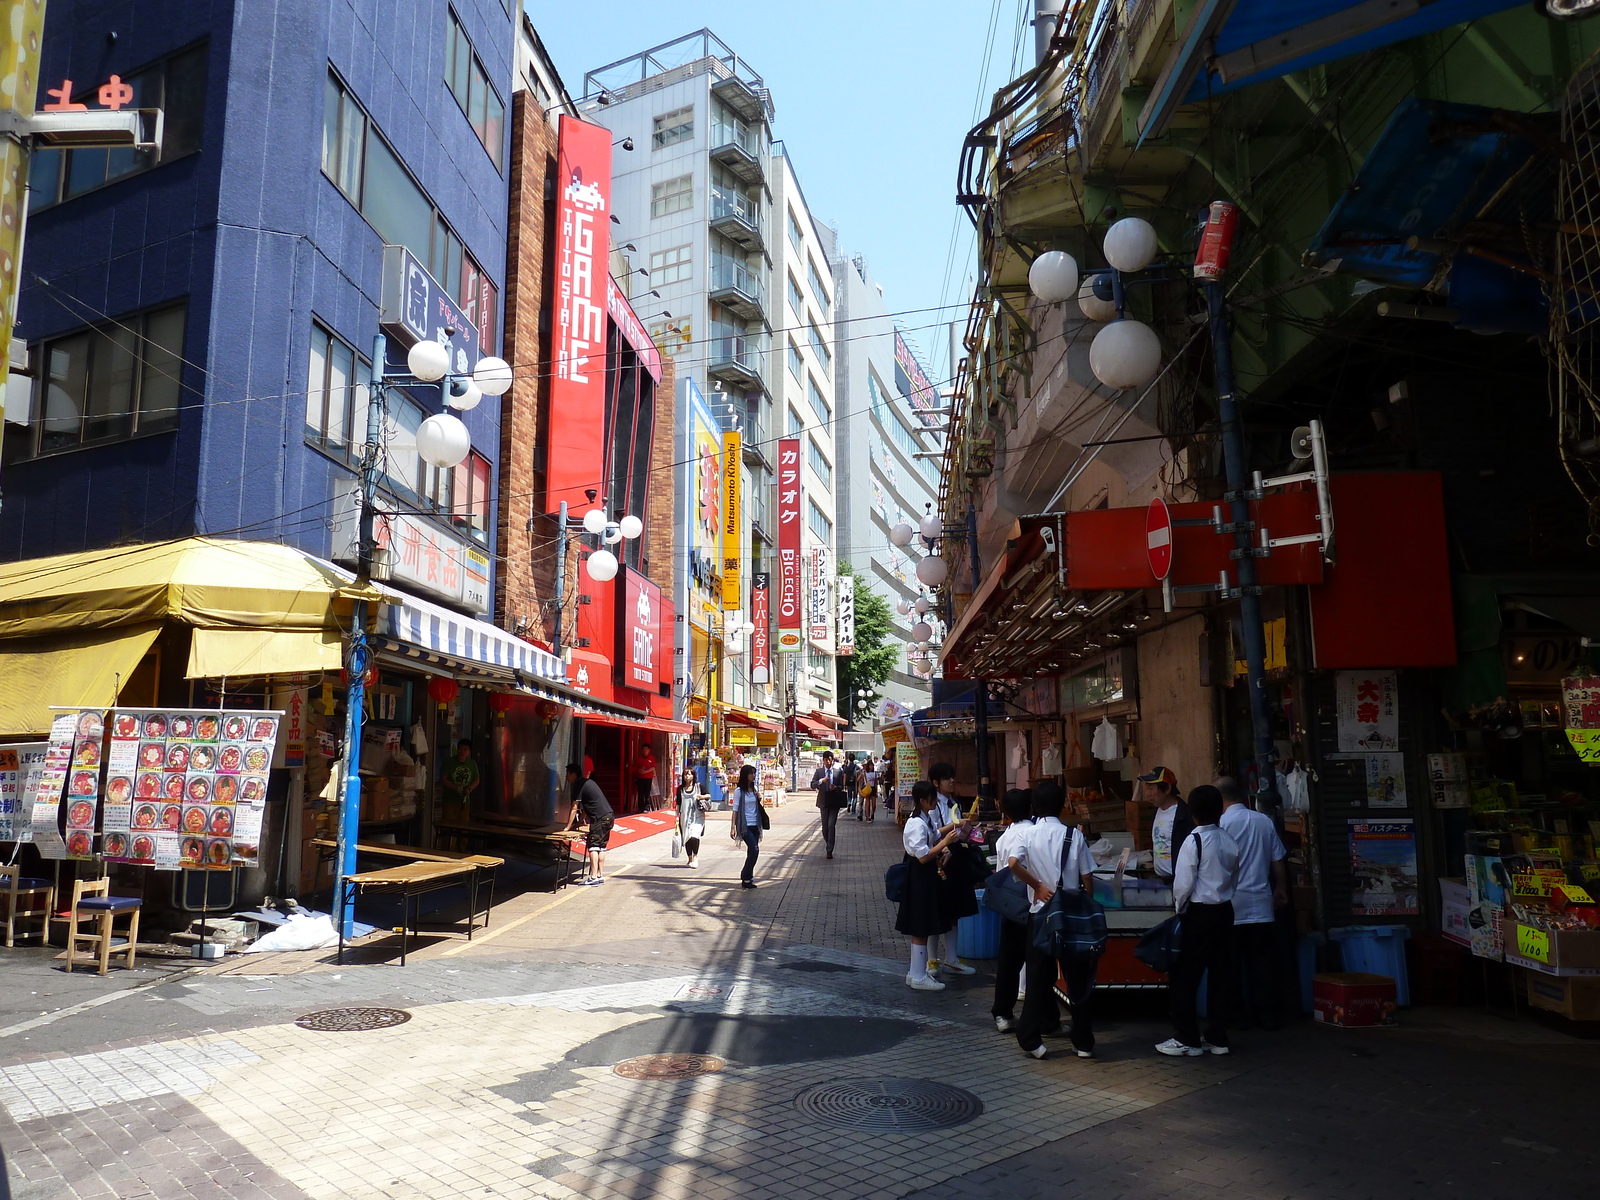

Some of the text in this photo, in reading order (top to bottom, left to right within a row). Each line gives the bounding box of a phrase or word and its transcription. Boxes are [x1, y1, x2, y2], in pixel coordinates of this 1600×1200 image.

[558, 208, 572, 380] TAITO STATION
[570, 211, 602, 384] GAME
[727, 442, 737, 535] Matsumoto KiYoshi
[780, 450, 798, 524] カラオケ
[724, 558, 738, 571] 薬
[781, 549, 795, 617] BIG ECHO
[633, 626, 653, 669] GAME
[840, 595, 853, 644] ルノアール
[1357, 680, 1379, 723] 大祭
